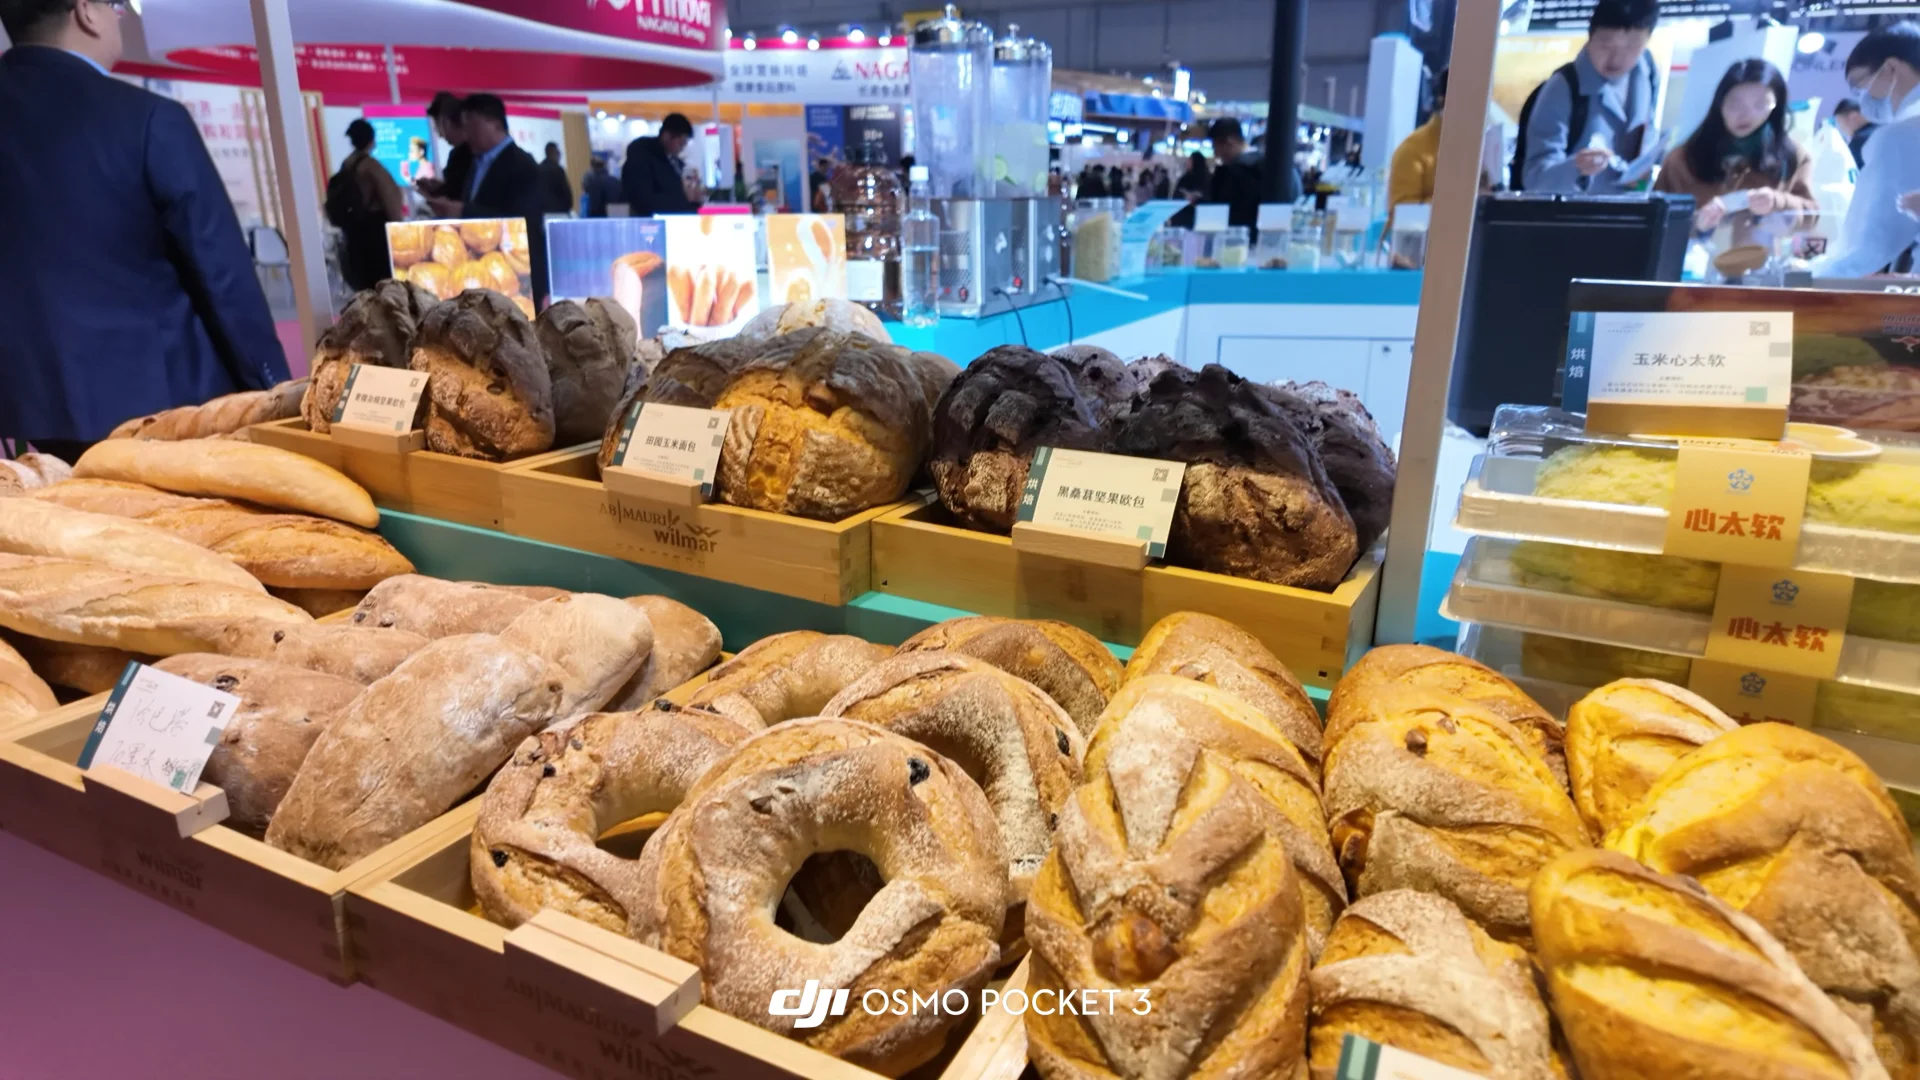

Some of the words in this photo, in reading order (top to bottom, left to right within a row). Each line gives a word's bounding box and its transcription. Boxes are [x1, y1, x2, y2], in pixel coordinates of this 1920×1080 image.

[1632, 352, 1726, 367] 玉米心太软
[645, 435, 696, 453] 田园玉米面包
[1056, 485, 1145, 509] 黑桑葚坚果欧包
[1684, 508, 1785, 541] 心太软
[654, 527, 718, 553] wilmar
[1727, 616, 1829, 653] 心太软
